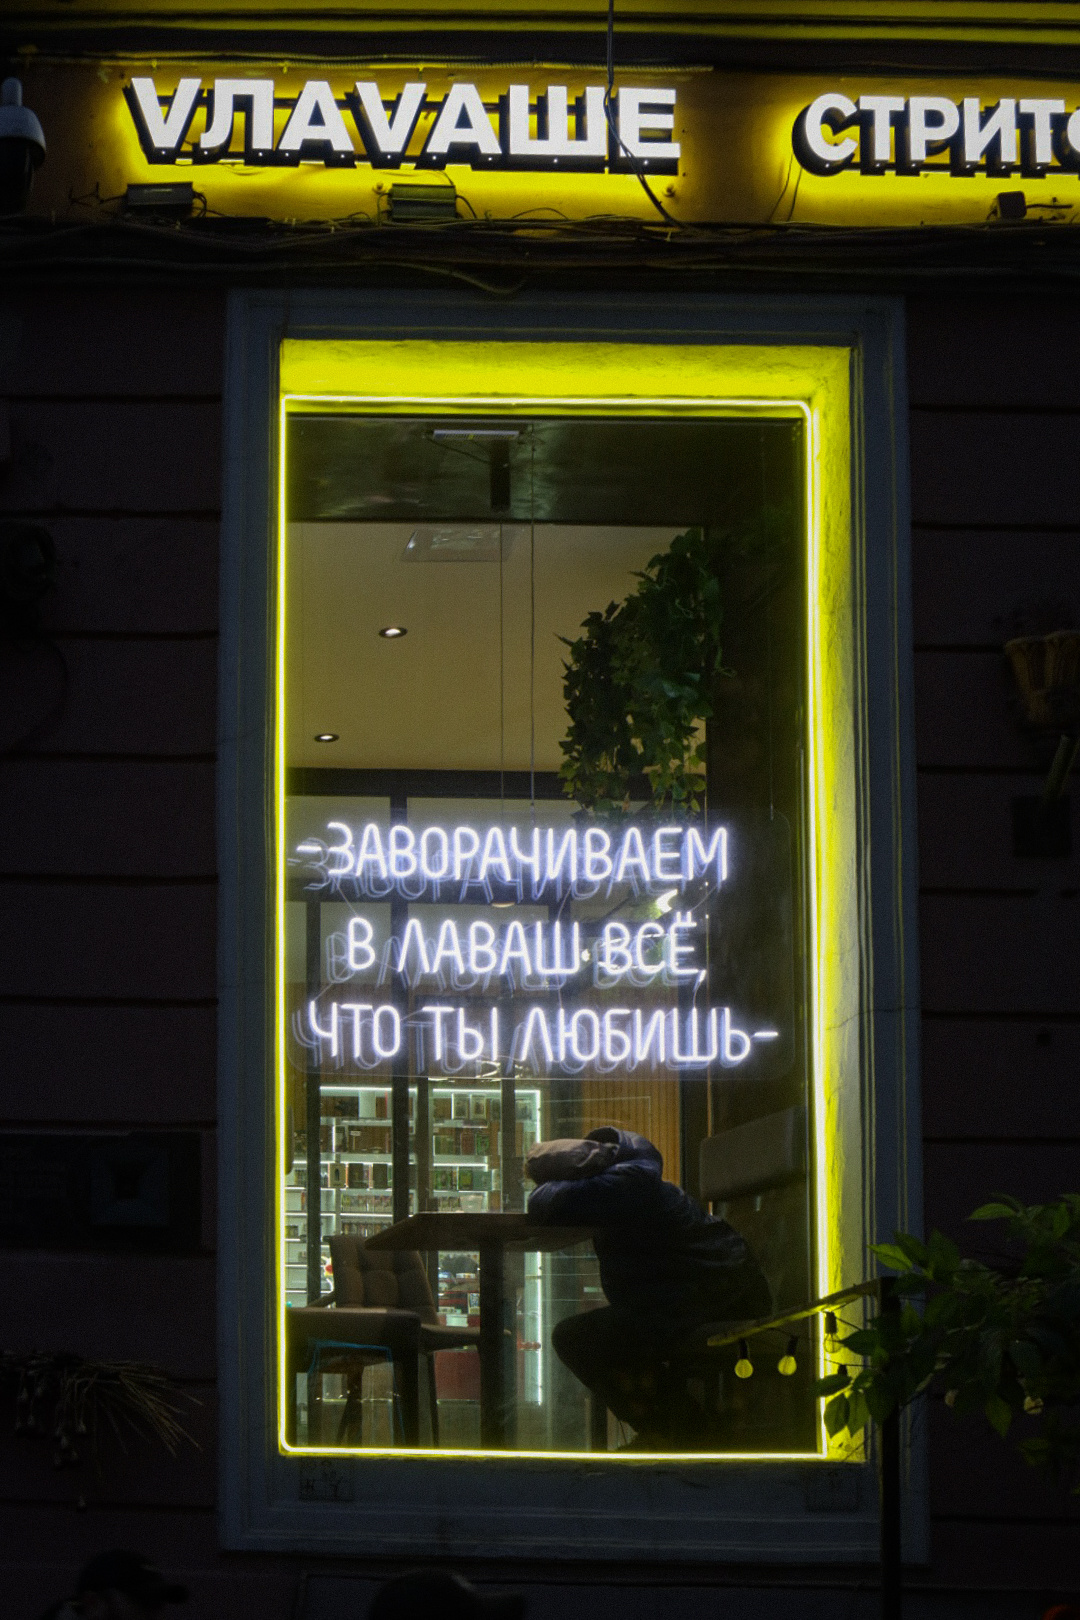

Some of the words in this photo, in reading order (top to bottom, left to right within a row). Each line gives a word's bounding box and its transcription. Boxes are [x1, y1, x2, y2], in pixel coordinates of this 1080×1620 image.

[805, 93, 1080, 163] СТРИТ
[346, 916, 376, 971] В
[397, 917, 581, 976] ЛАВАШ
[309, 1000, 402, 1059] ЧТО
[421, 1005, 499, 1062] ТЫ
